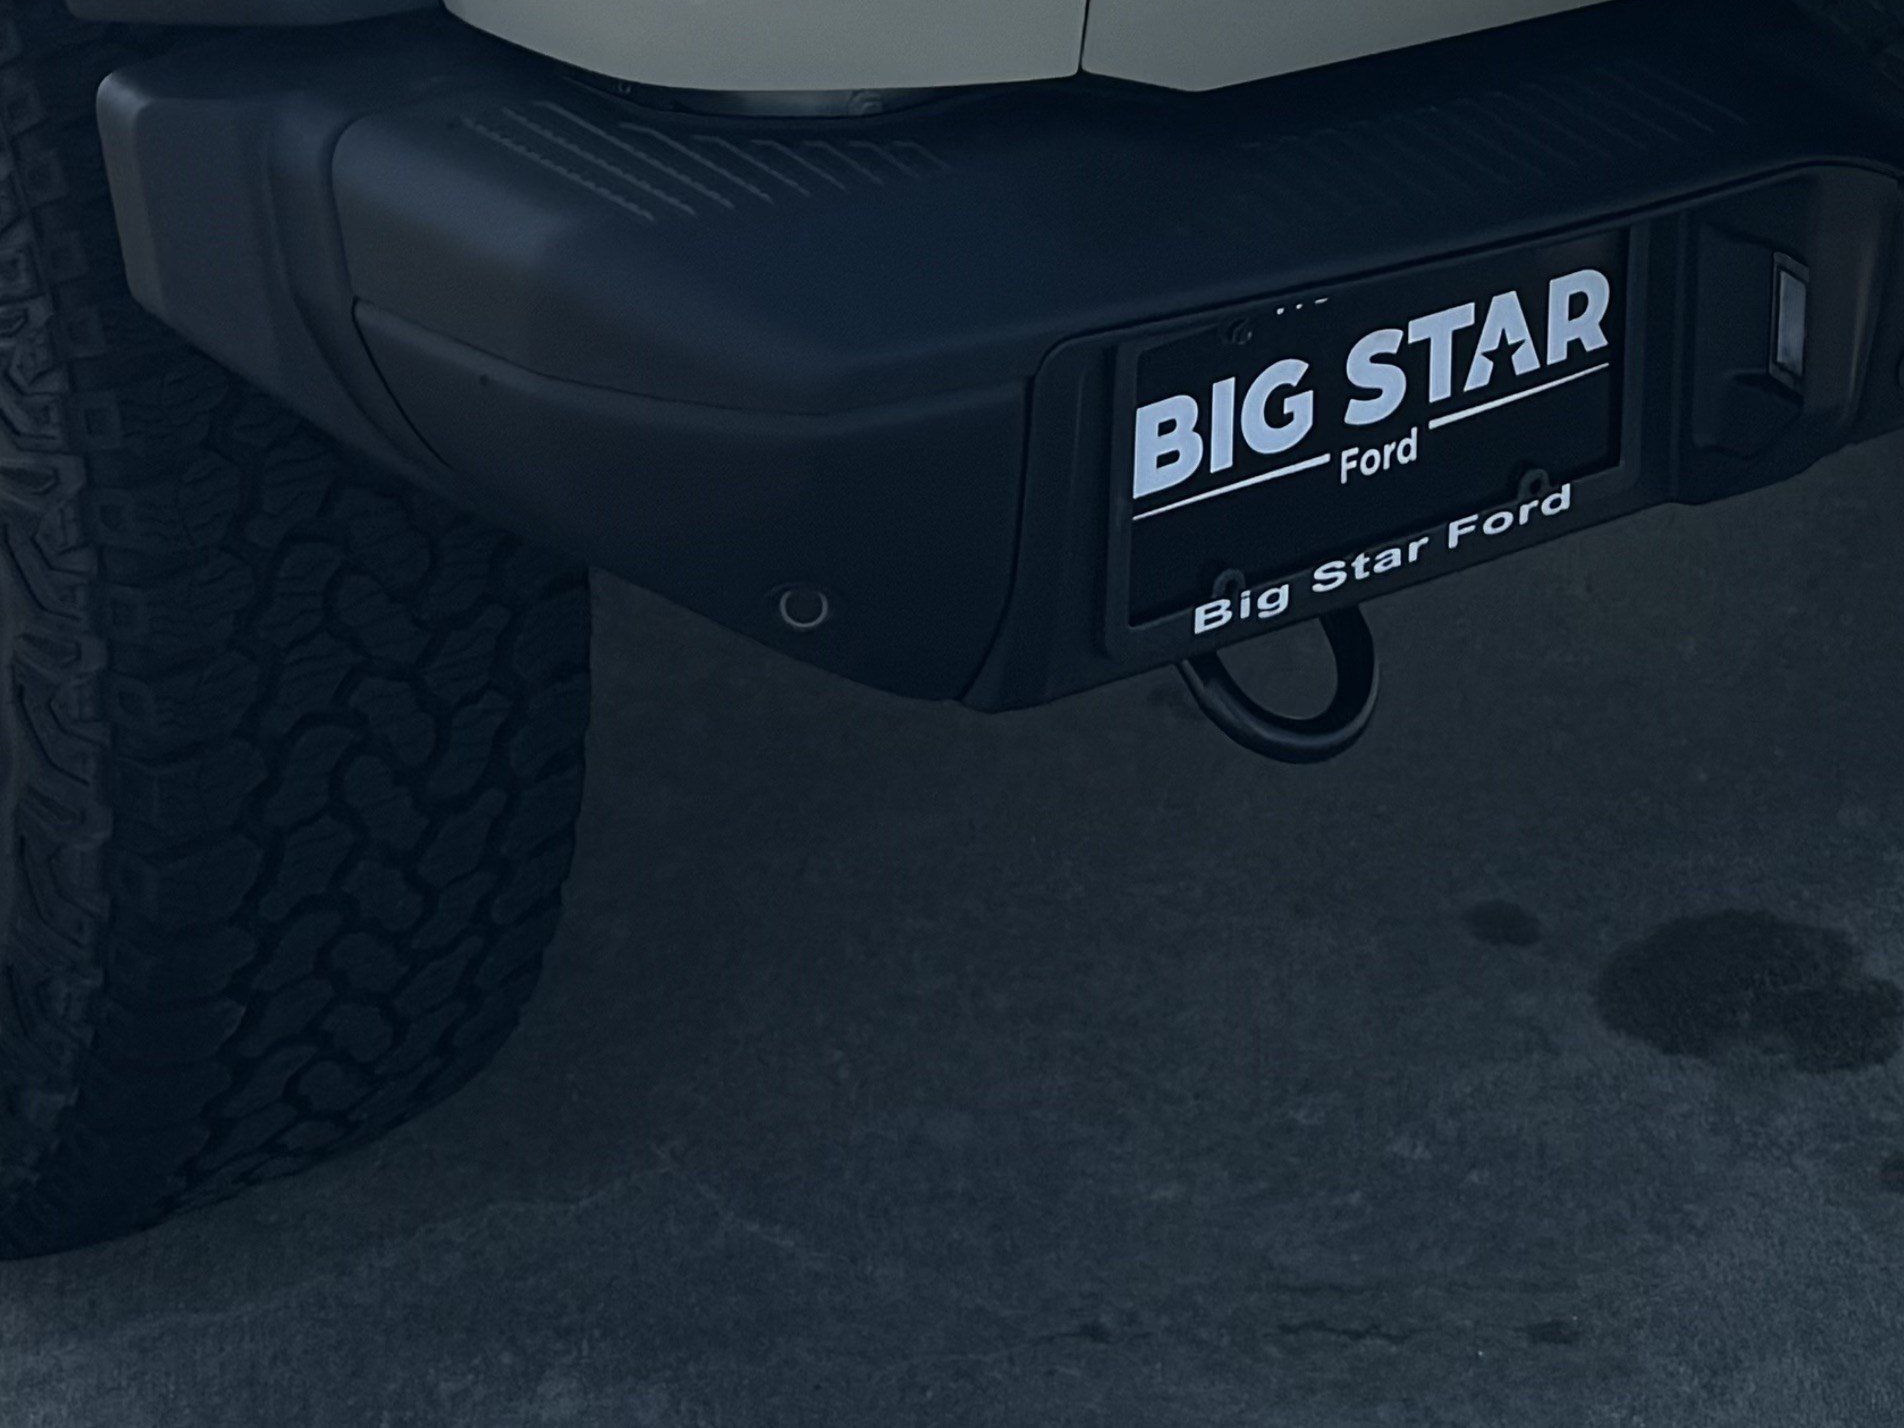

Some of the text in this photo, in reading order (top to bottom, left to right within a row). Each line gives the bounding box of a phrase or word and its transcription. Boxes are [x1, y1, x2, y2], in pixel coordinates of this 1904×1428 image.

[1132, 269, 1610, 499] BIG STAR
[1340, 427, 1418, 484] Ford
[1194, 483, 1572, 635] Big Star Ford
